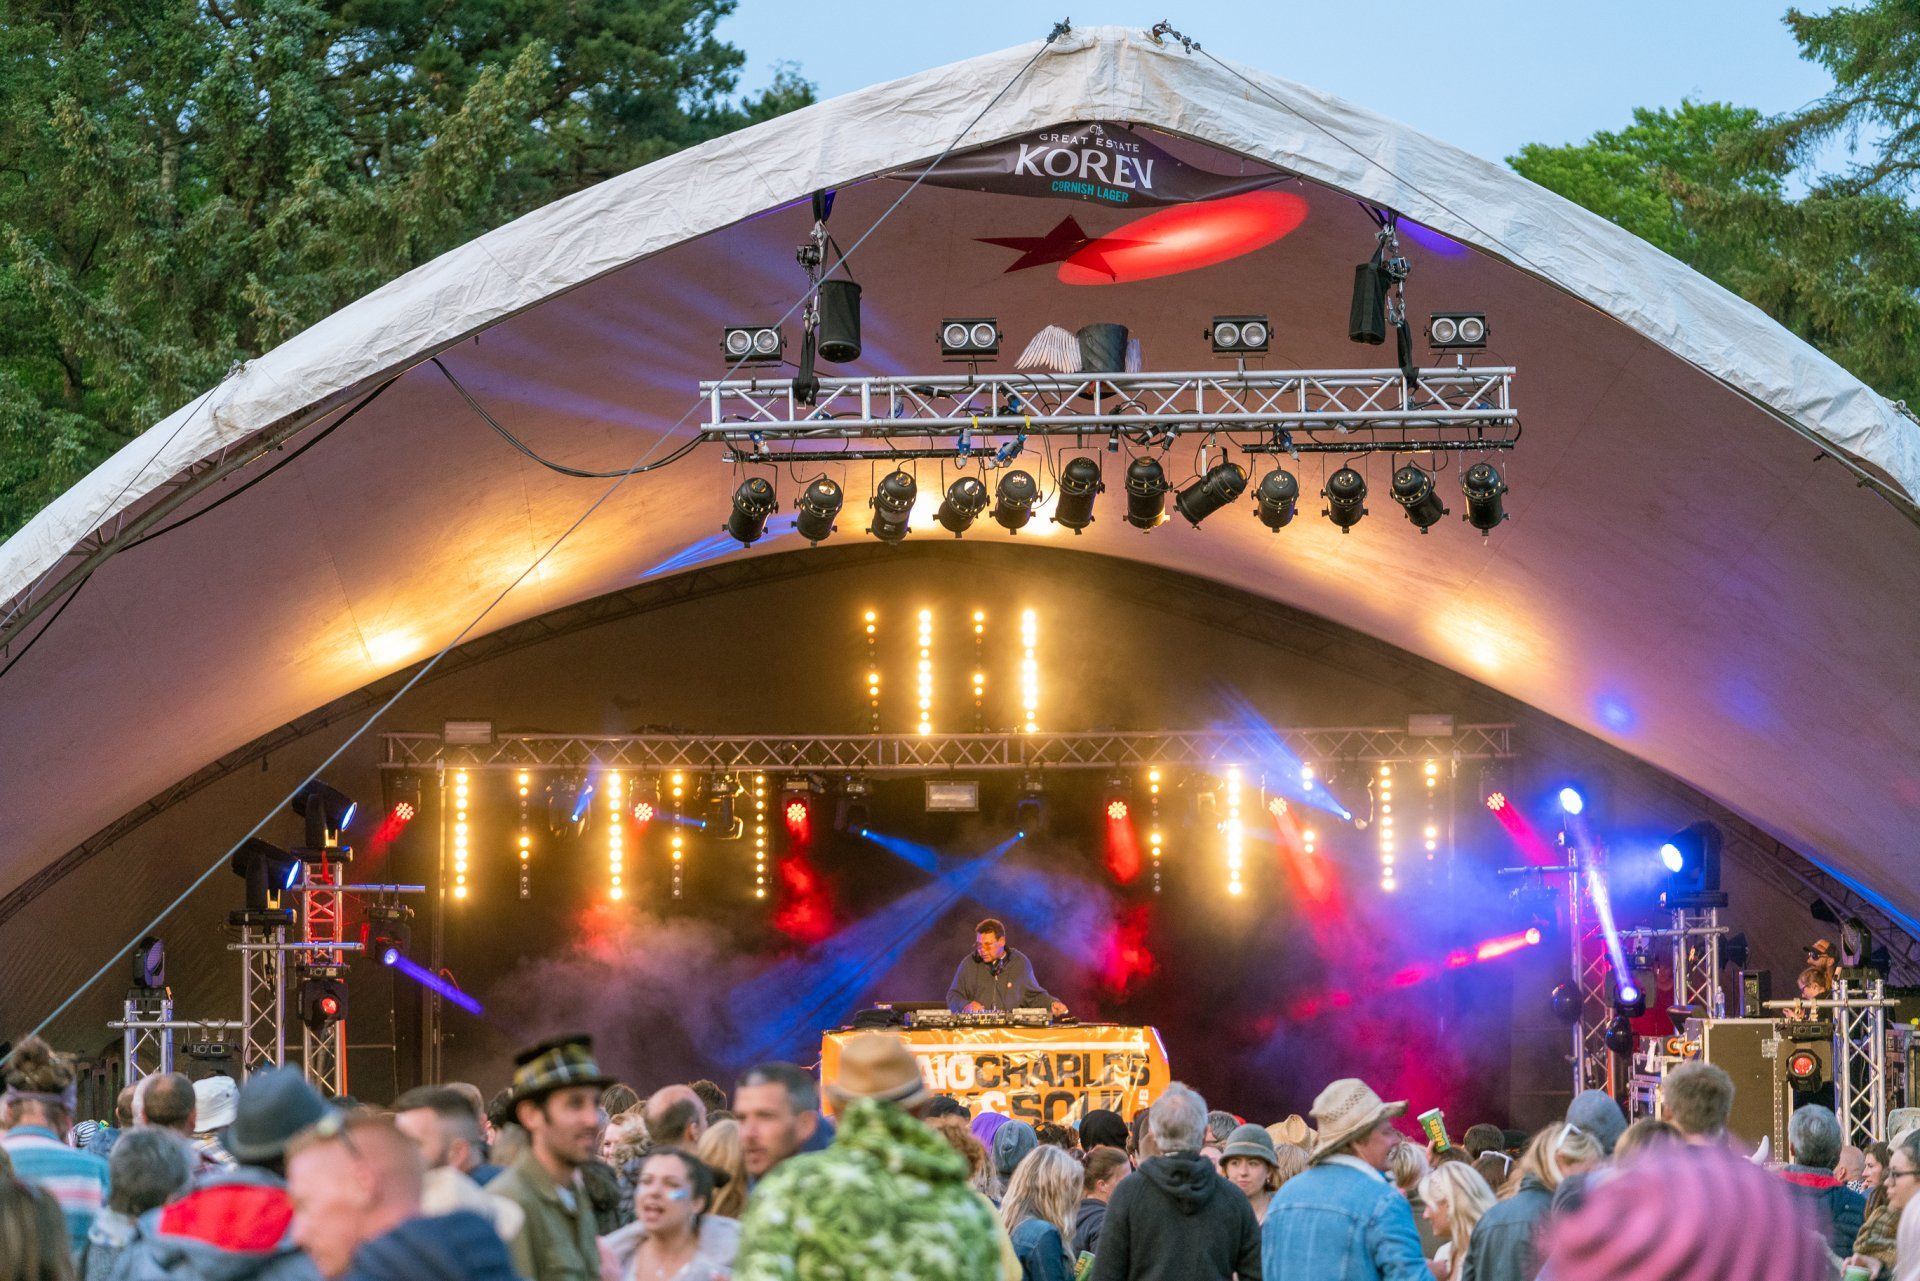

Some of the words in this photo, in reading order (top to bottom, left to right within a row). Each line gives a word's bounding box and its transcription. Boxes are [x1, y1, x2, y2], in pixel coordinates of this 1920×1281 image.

[1039, 133, 1088, 145] GREAT
[1096, 138, 1139, 153] ESTATE
[1014, 143, 1154, 189] KOREV
[1051, 180, 1095, 196] CORNISH
[1097, 186, 1129, 202] LAGER
[915, 1054, 974, 1090] AIG
